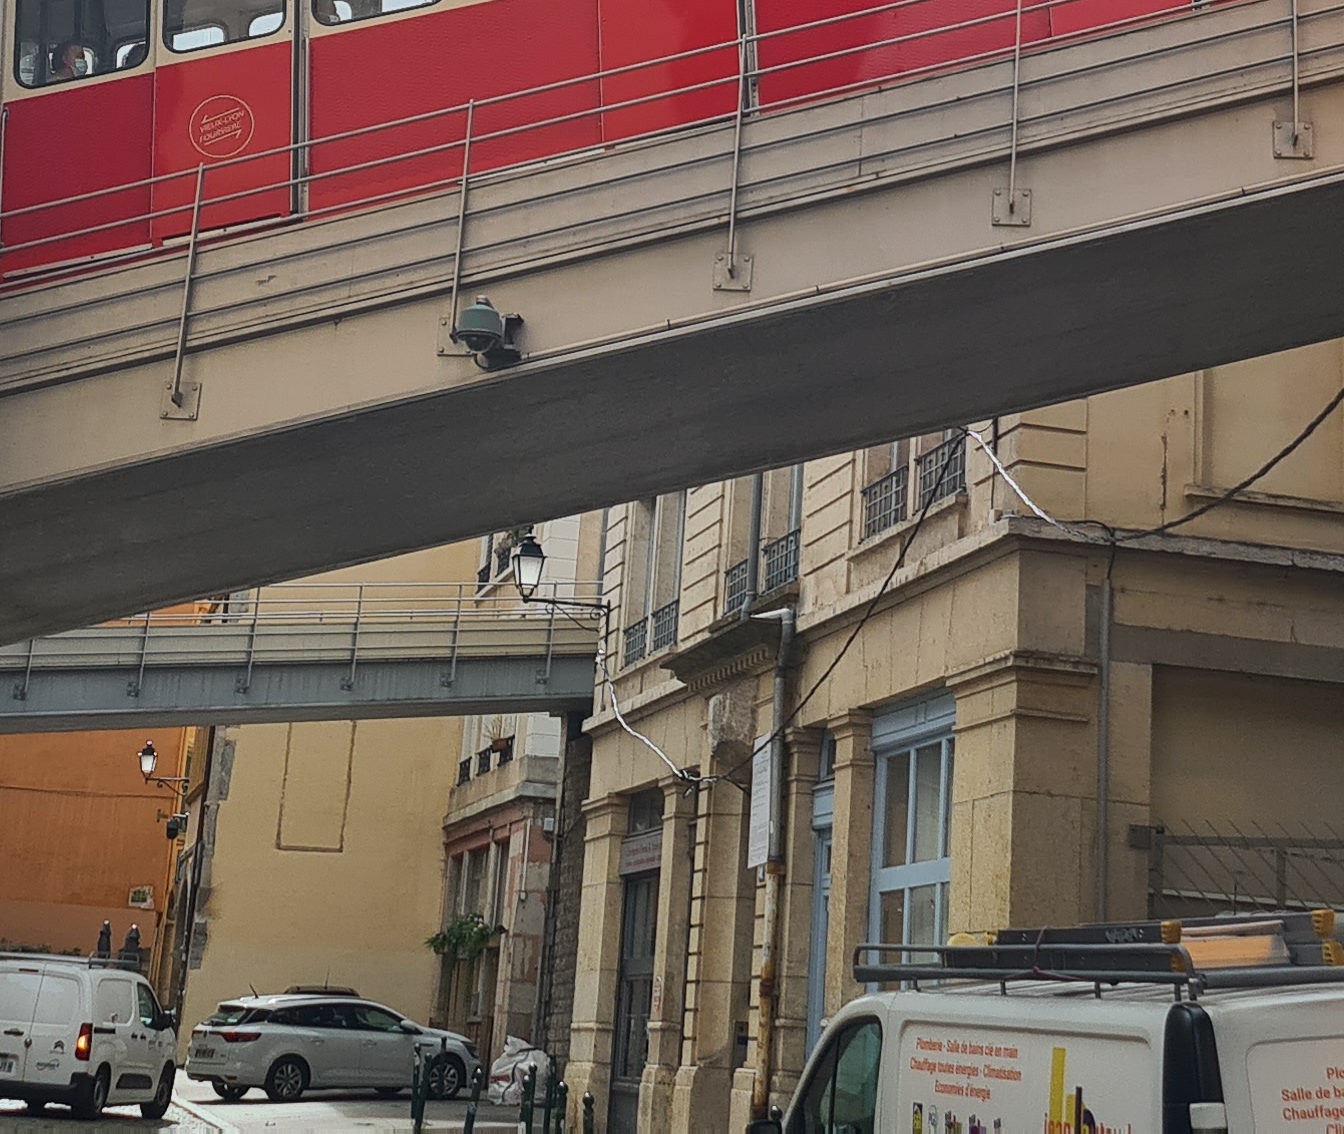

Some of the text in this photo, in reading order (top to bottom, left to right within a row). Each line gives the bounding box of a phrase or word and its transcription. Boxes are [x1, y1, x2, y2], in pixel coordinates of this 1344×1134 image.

[916, 1037, 1019, 1058] Plomberie Salle de bains clé en main
[910, 1057, 1022, 1081] Chauffage toutes énergies Climatisation
[1281, 1087, 1313, 1102] Salle
[1315, 1086, 1331, 1100] de
